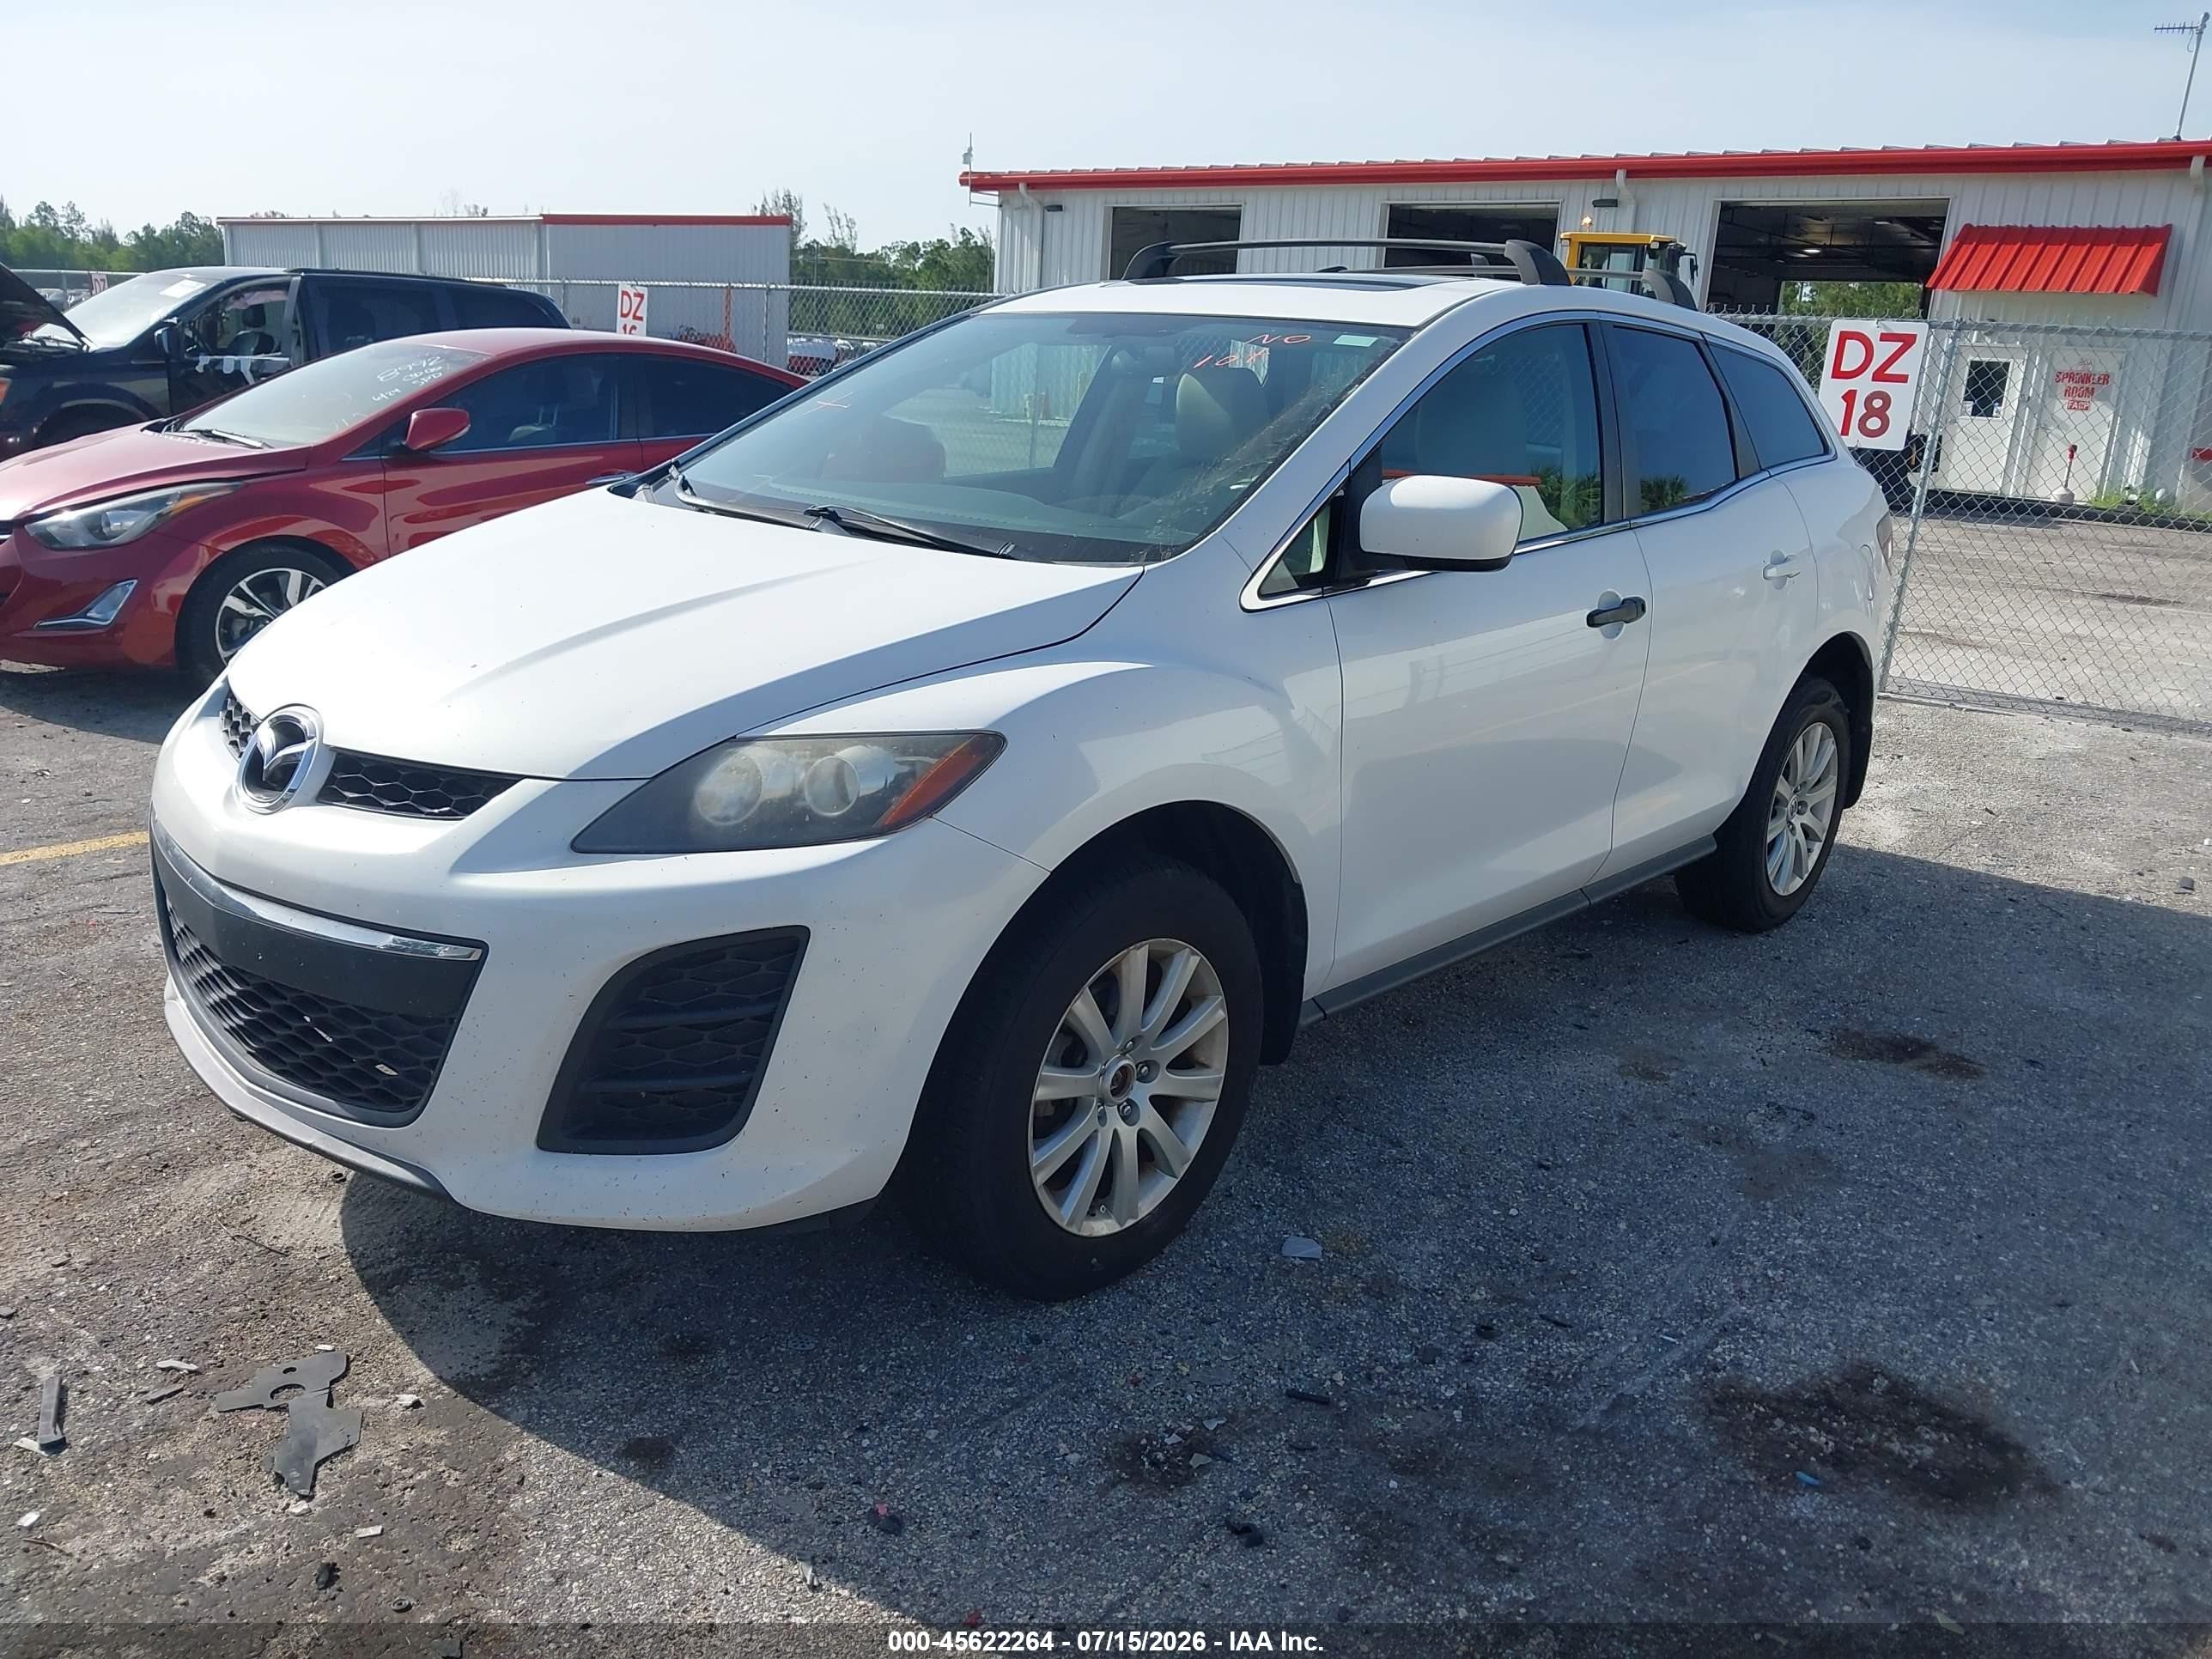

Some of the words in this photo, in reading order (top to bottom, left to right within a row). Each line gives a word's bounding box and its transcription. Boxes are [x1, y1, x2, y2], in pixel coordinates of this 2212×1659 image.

[620, 289, 645, 321] DZ
[1831, 330, 1917, 384] DZ
[2055, 372, 2110, 385] SPRINKLER
[2063, 386, 2095, 398] ROOM
[1840, 389, 1892, 438] 18
